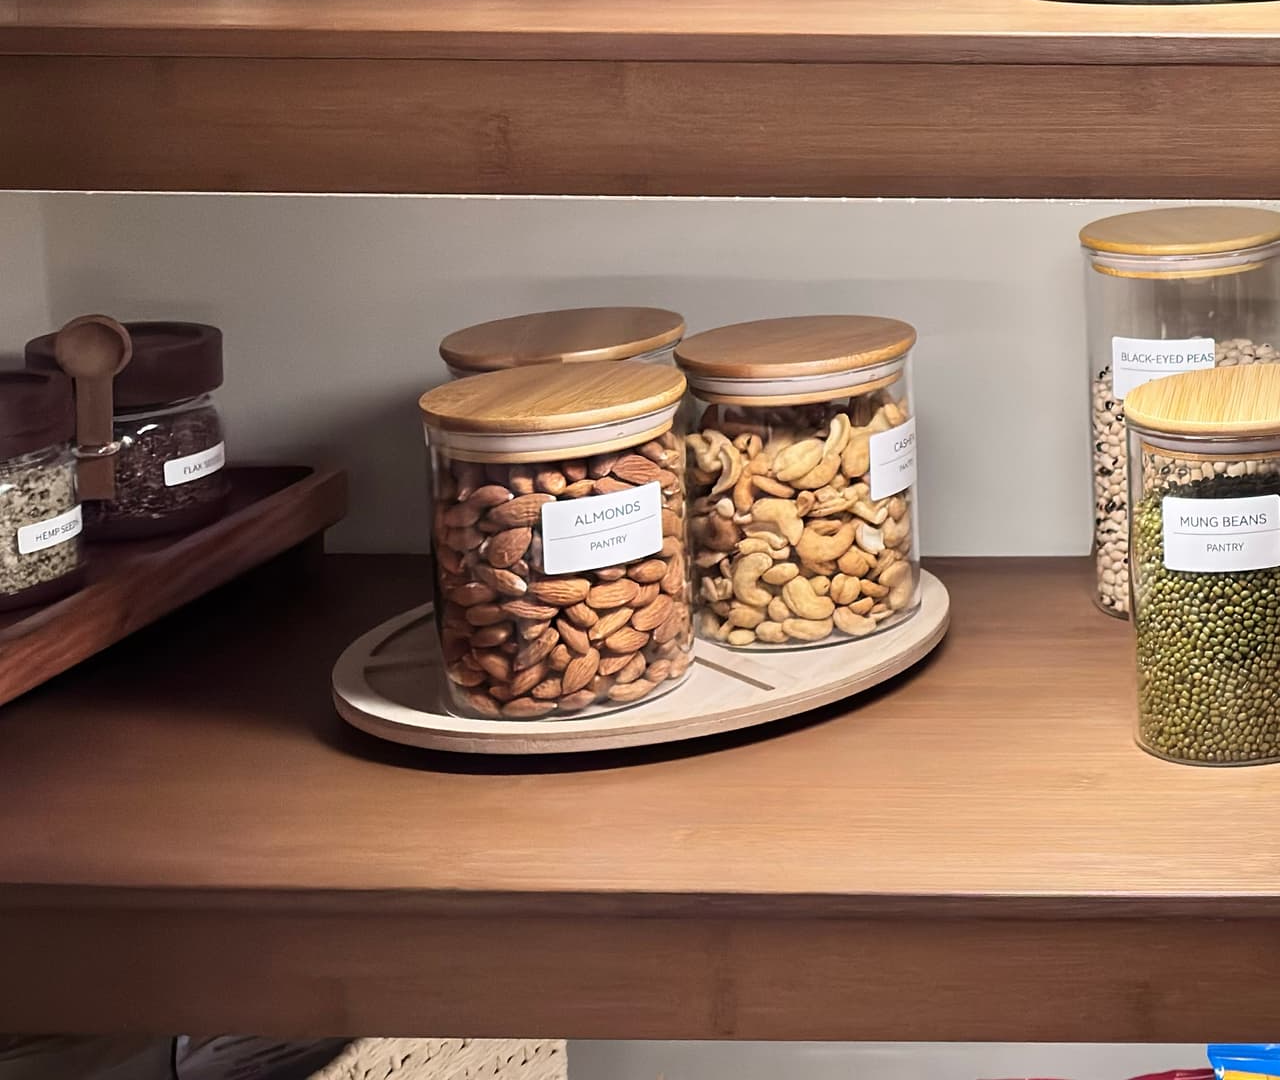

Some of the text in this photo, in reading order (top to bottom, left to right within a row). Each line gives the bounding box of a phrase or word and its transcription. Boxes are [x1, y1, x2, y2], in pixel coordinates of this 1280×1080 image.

[1120, 352, 1214, 364] BLACK-EYED PEAS
[573, 500, 642, 527] ALMONDS
[1179, 513, 1268, 528] MUNG BEANS
[35, 527, 60, 542] HEMP
[589, 533, 629, 552] PANTRY
[1206, 542, 1245, 554] PANTRY
